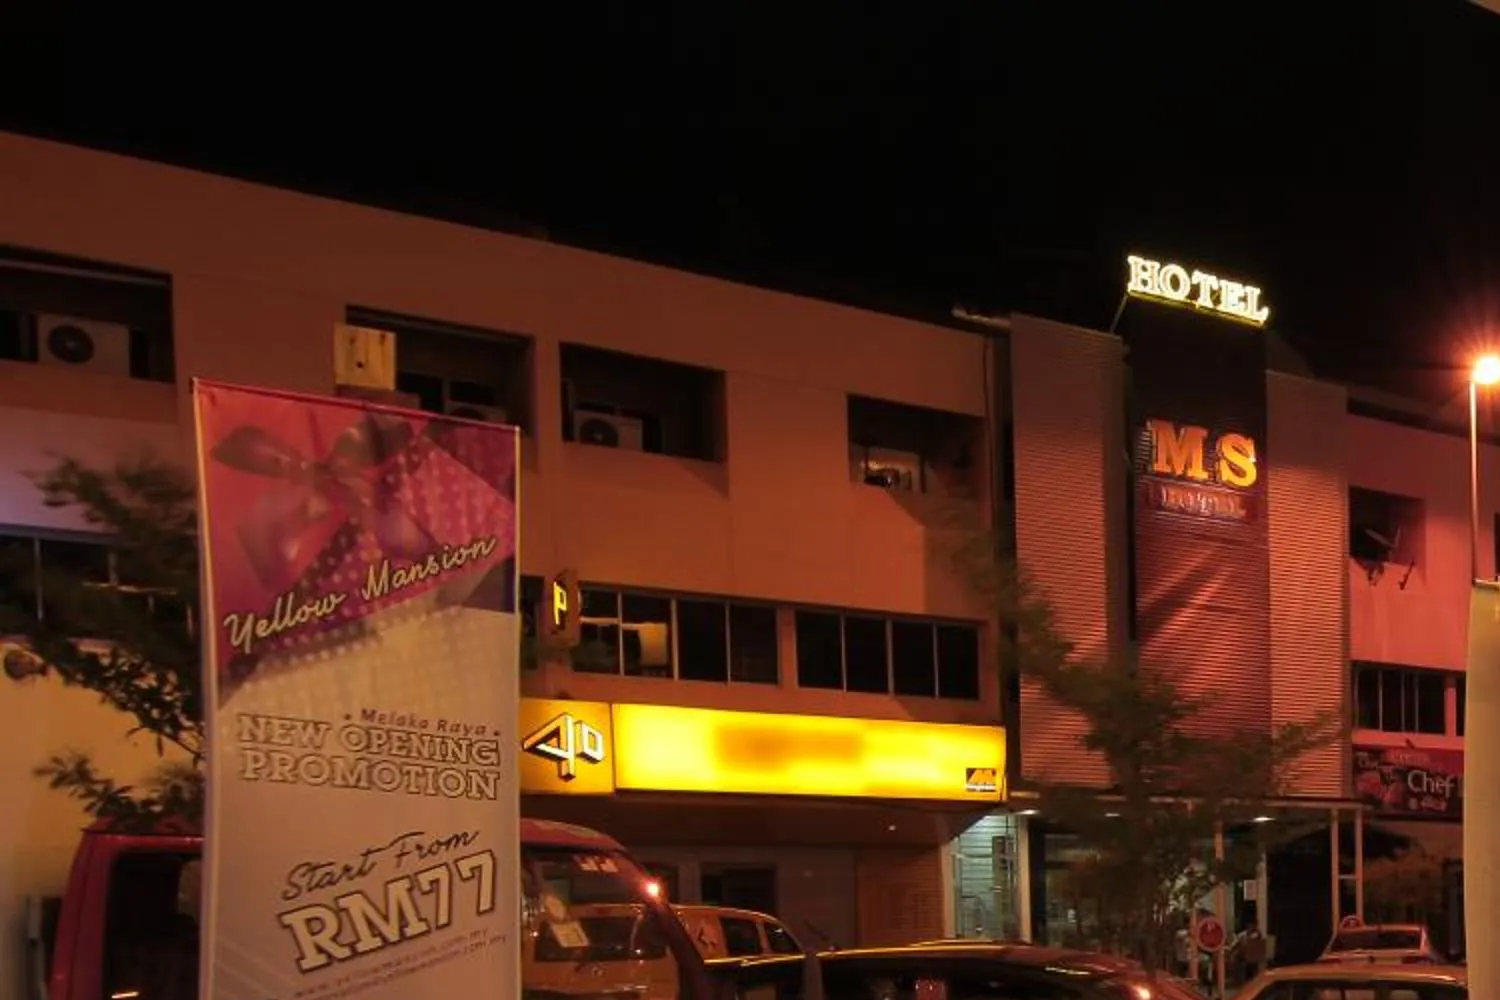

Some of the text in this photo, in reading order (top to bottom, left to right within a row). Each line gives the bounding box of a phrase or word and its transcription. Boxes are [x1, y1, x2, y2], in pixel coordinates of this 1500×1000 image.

[1127, 255, 1269, 324] HOTEL
[223, 538, 497, 654] Yellow Mansion
[238, 713, 500, 766] NEW OPENING
[240, 747, 500, 800] PROMOTION
[1407, 769, 1455, 799] Chef
[281, 831, 479, 900] Start From
[277, 848, 496, 974] RM77
